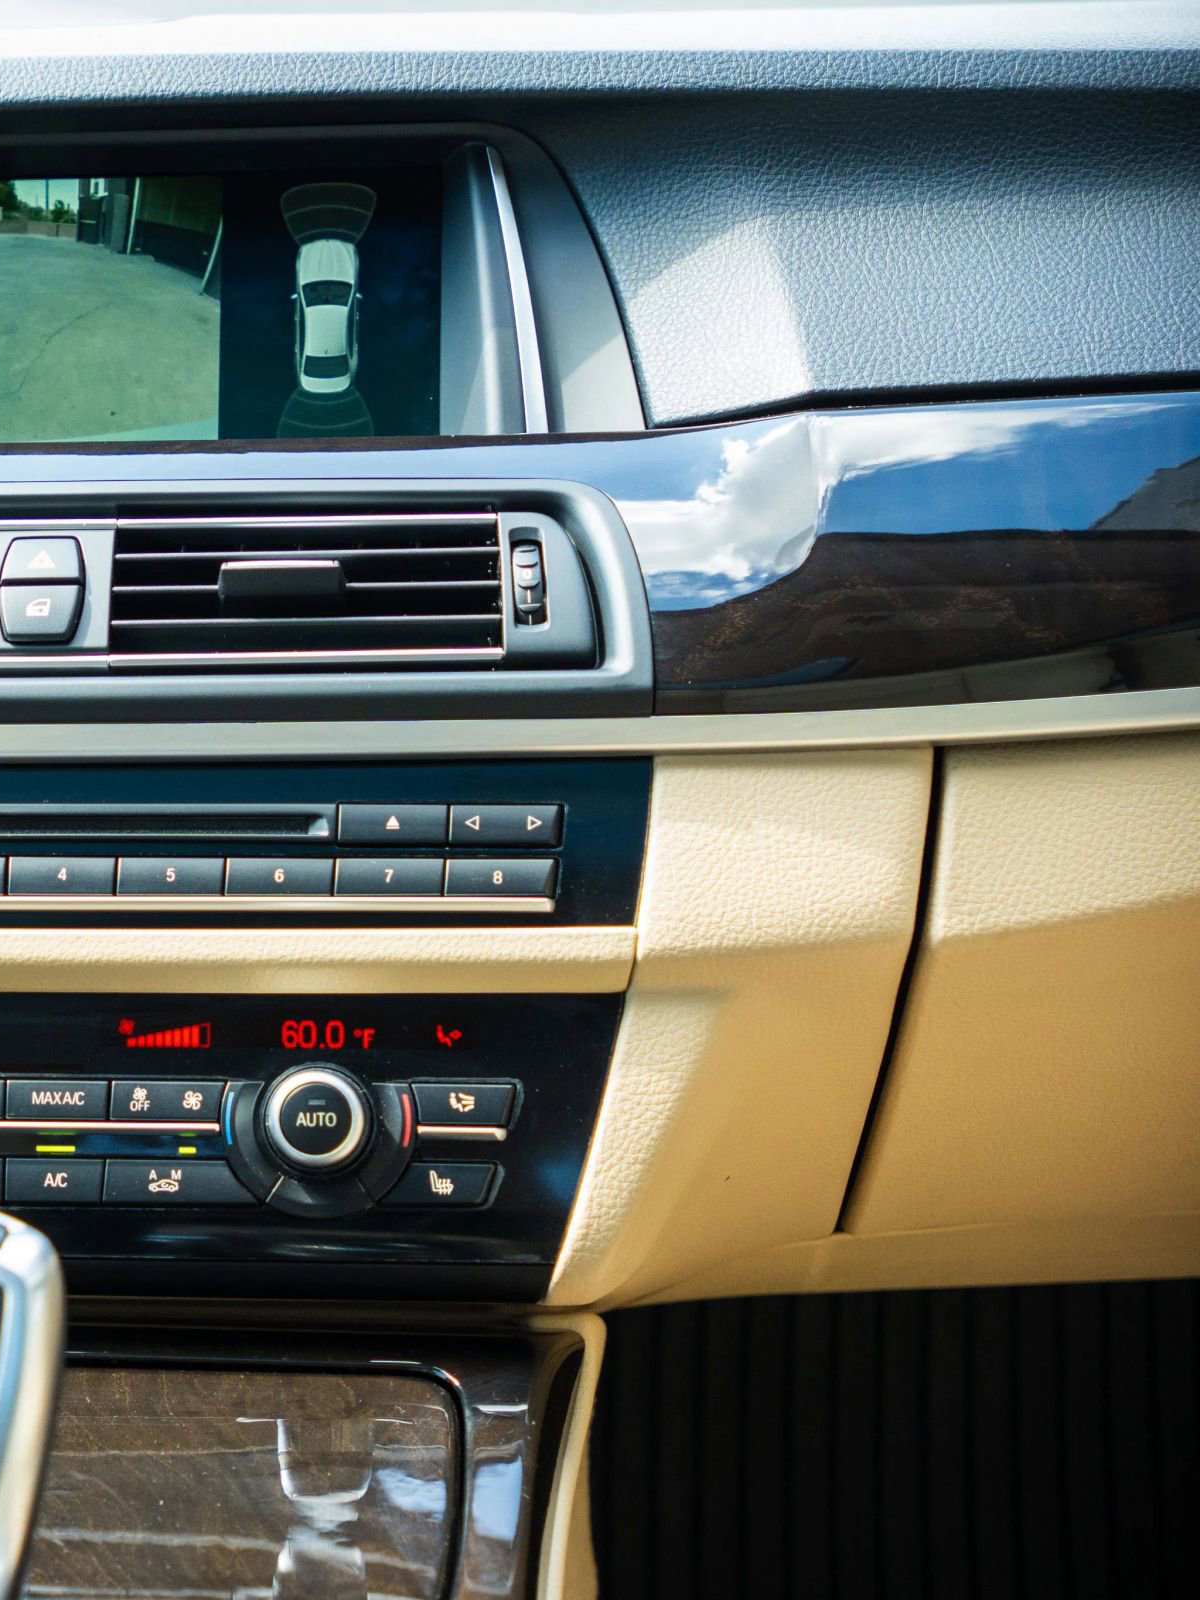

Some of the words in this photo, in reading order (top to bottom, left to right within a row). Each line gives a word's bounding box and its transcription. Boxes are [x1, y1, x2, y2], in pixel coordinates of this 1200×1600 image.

[57, 868, 67, 881] 4
[166, 868, 176, 882] 5
[274, 869, 284, 883] 6
[384, 869, 394, 883] 7
[492, 870, 503, 884] 8
[281, 1019, 345, 1049] 60.0
[129, 1100, 150, 1112] OFF
[296, 1112, 337, 1127] AUTO
[43, 1172, 68, 1188] A/C
[148, 1170, 158, 1180] A
[171, 1169, 182, 1180] M
